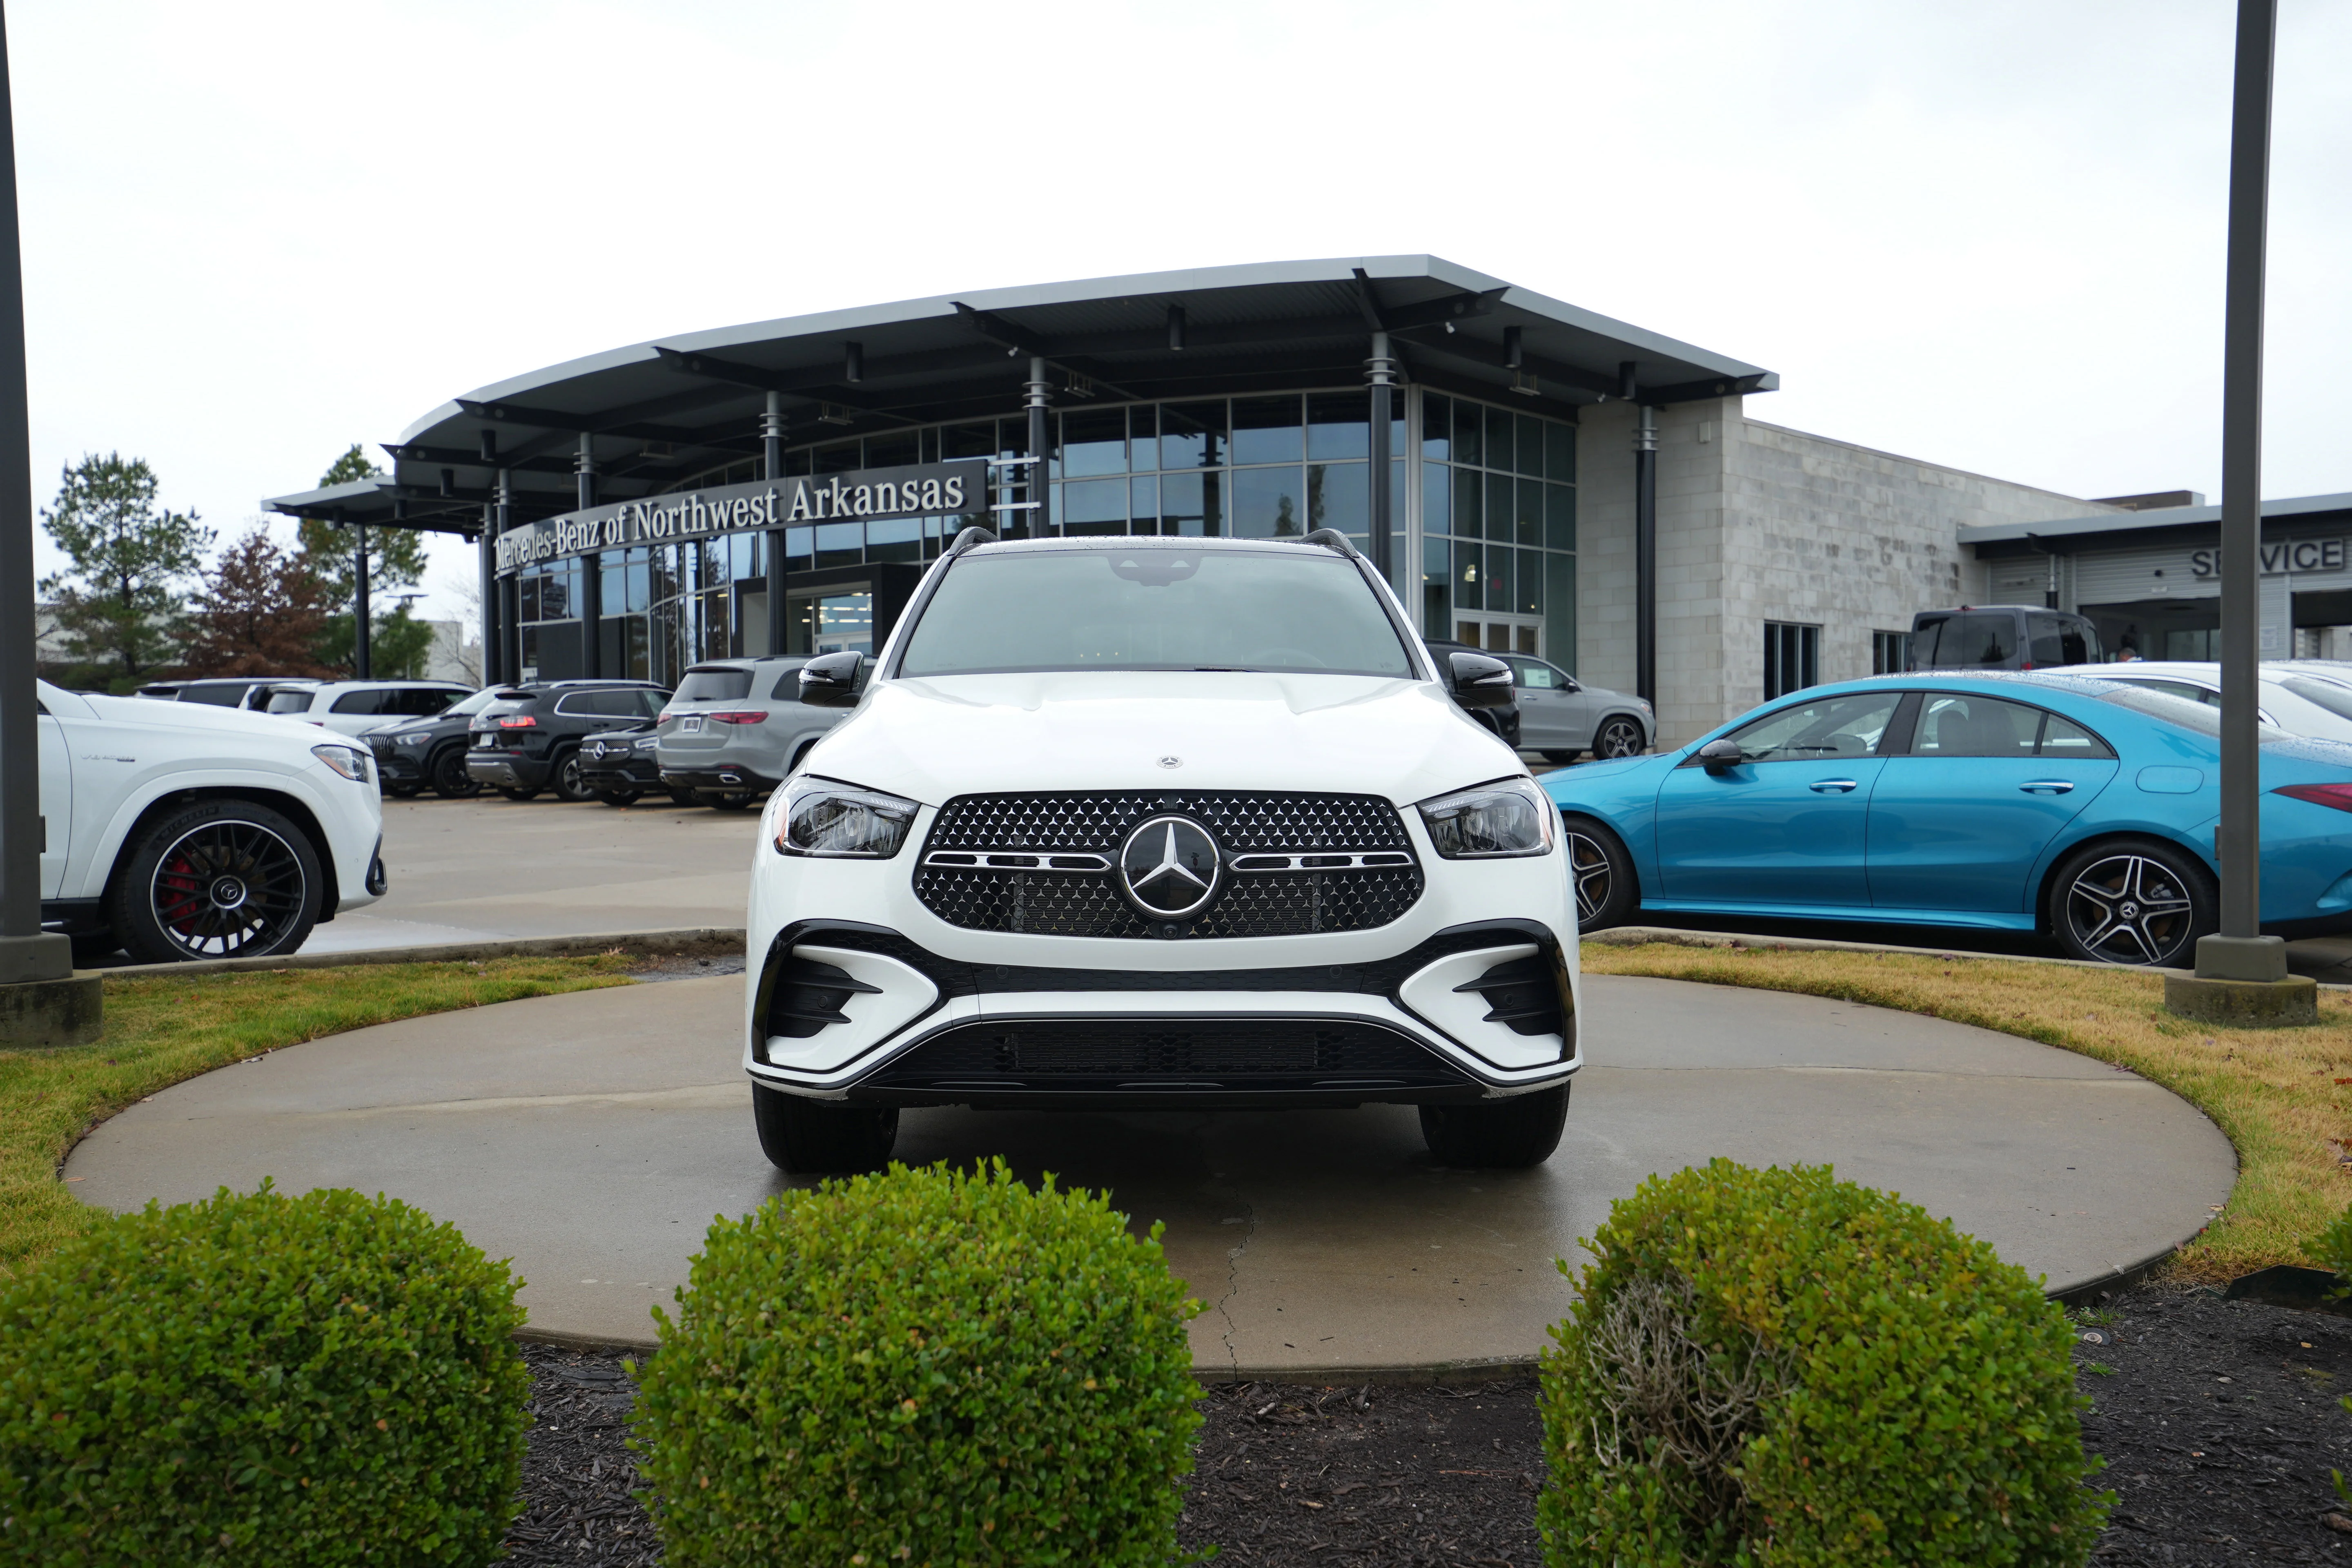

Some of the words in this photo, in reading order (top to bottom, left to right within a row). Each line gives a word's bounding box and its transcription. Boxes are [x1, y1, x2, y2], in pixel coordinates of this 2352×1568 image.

[493, 517, 599, 572] Mercedes-Benz
[605, 505, 628, 545] of
[633, 487, 777, 541] Northwest
[787, 476, 964, 521] Arkansas
[2191, 540, 2341, 577] SVICE
[161, 806, 216, 838] MICHELIN
